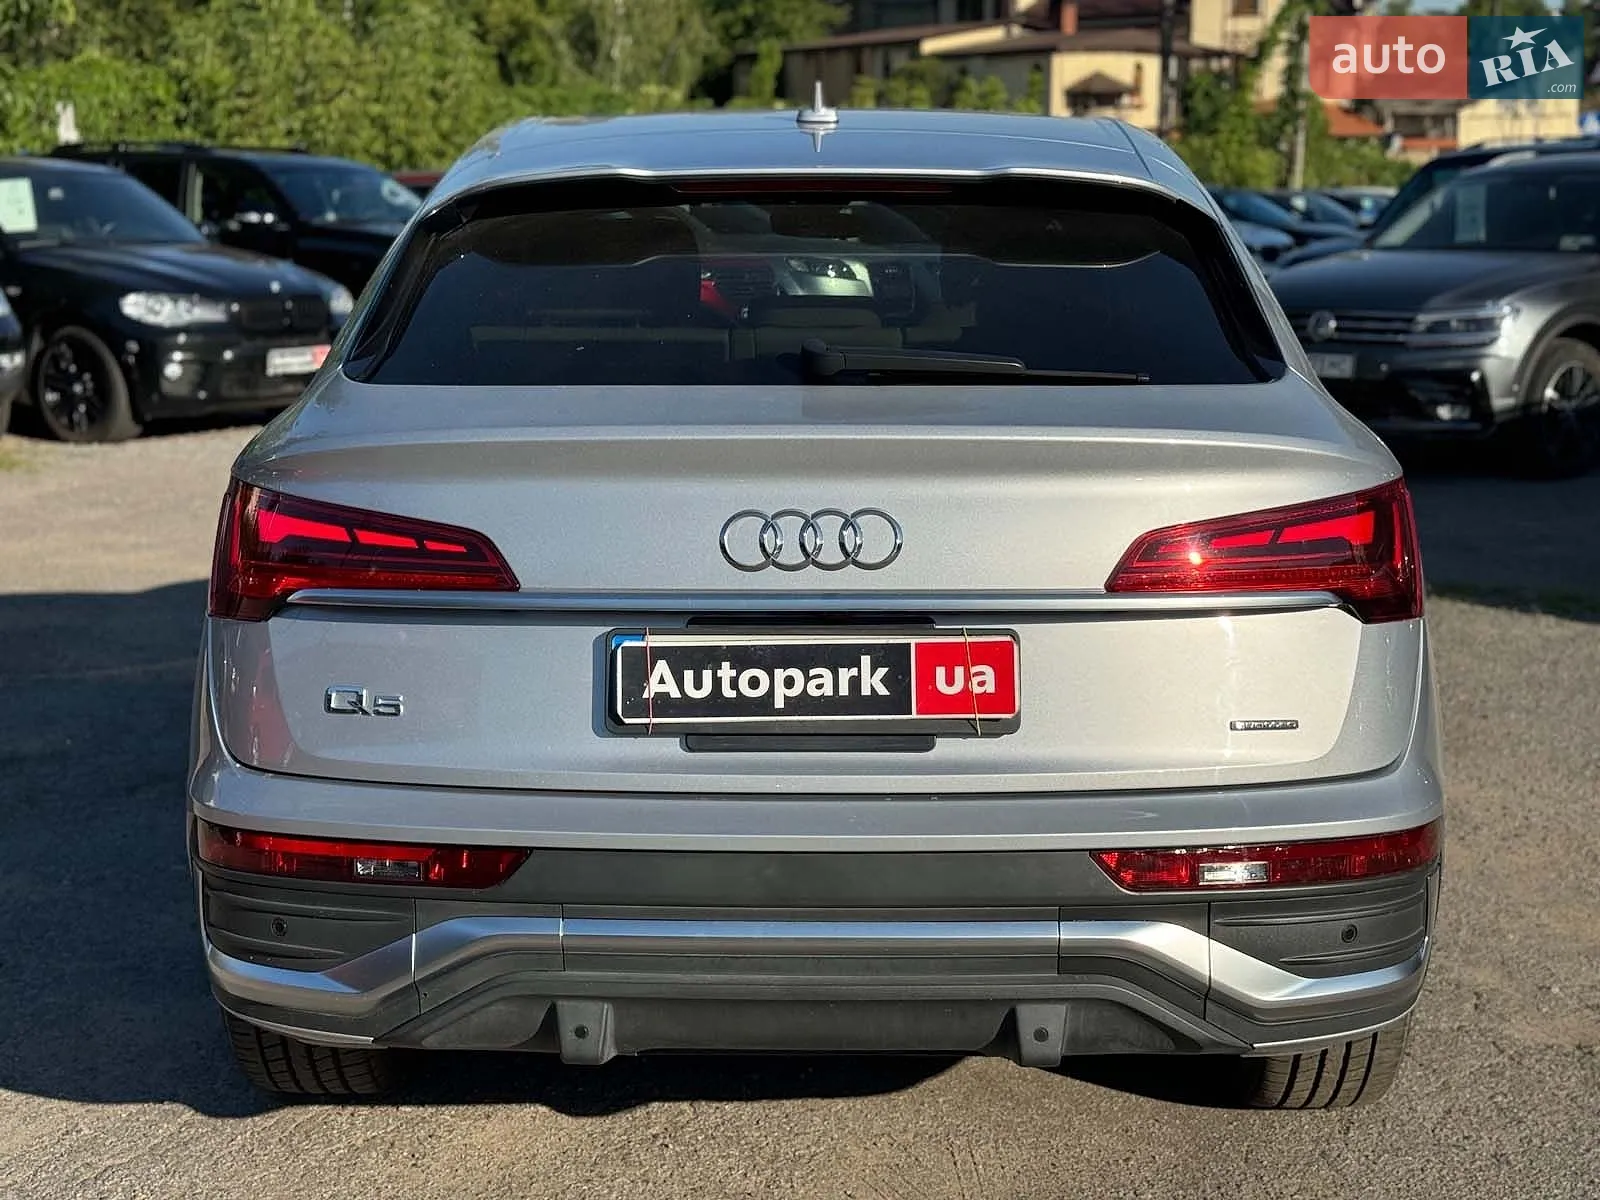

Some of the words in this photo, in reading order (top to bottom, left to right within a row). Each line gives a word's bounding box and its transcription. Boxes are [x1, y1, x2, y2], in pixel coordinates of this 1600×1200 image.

[324, 686, 404, 717] Q5
[642, 655, 891, 709] Autopark
[935, 663, 997, 694] ua
